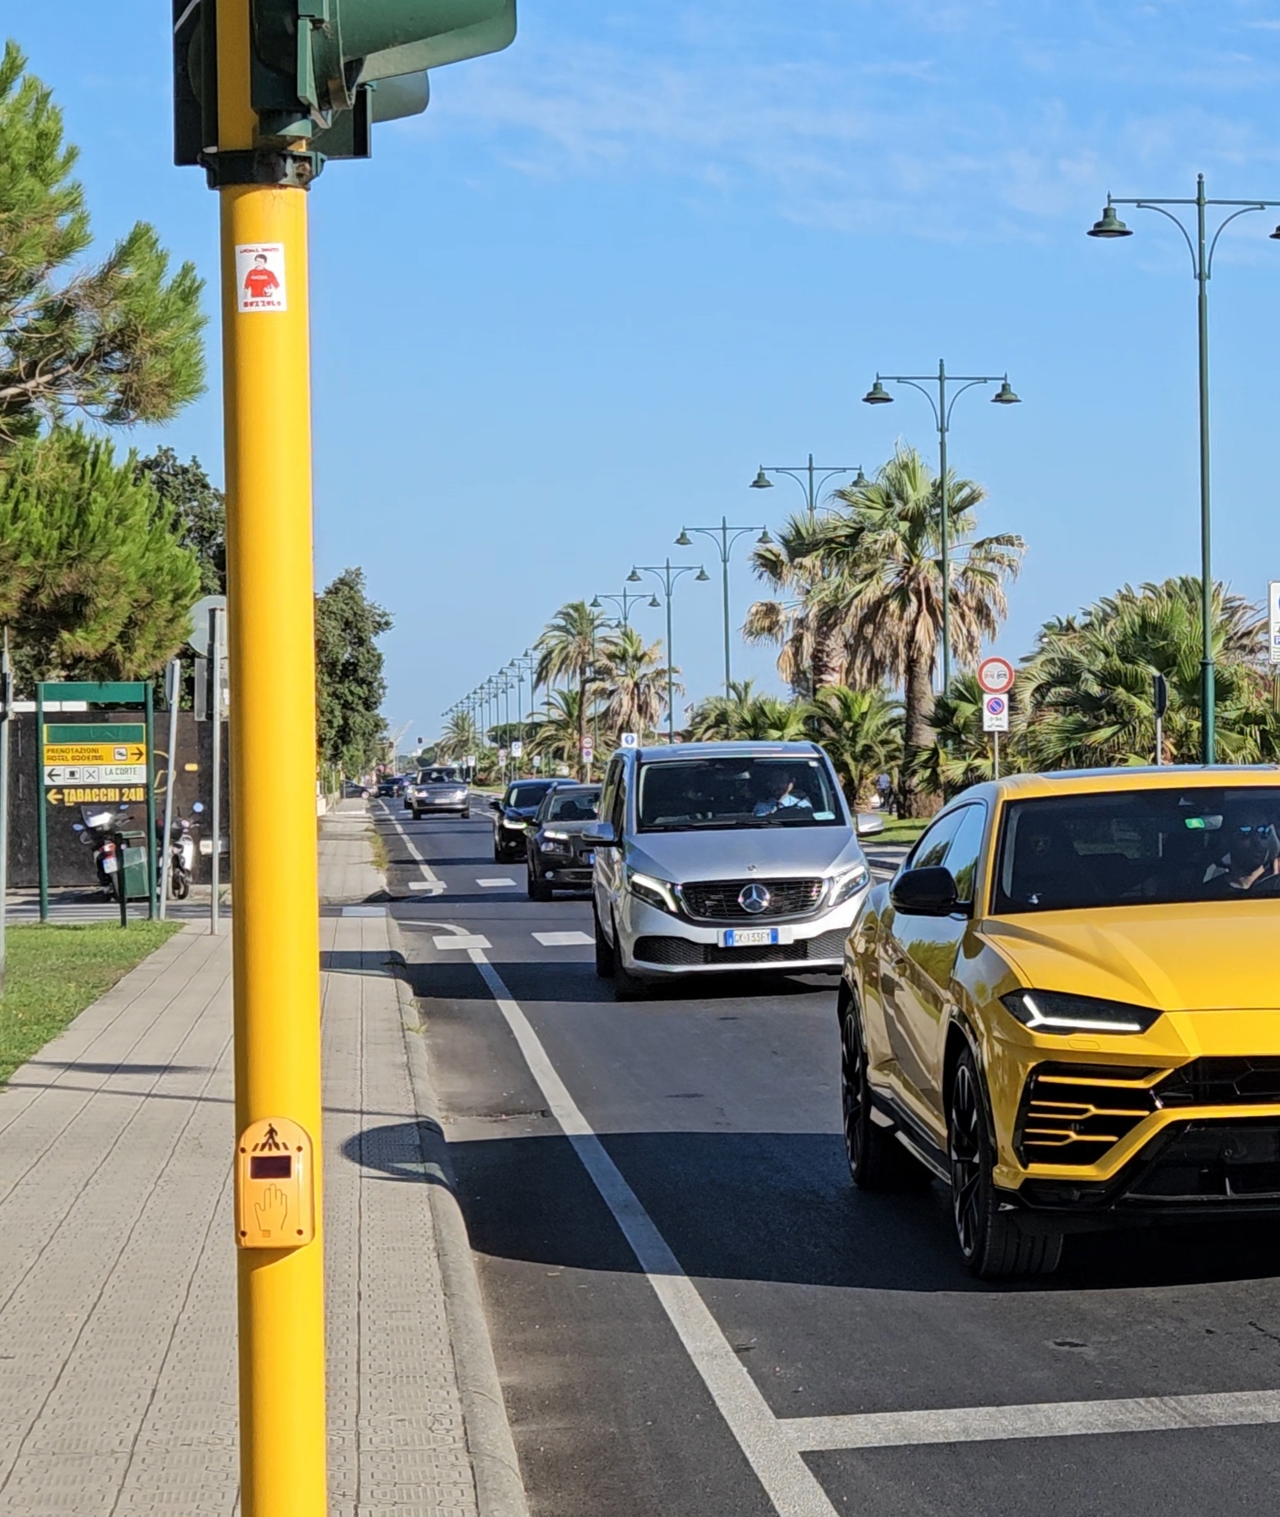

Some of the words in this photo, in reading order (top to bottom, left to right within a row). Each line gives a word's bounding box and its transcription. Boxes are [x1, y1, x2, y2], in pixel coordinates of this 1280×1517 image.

[71, 754, 104, 762] BOOKING
[104, 767, 114, 776] LA
[115, 767, 138, 776] CORTE
[62, 788, 120, 802] TABACCHI
[121, 787, 144, 802] 24H
